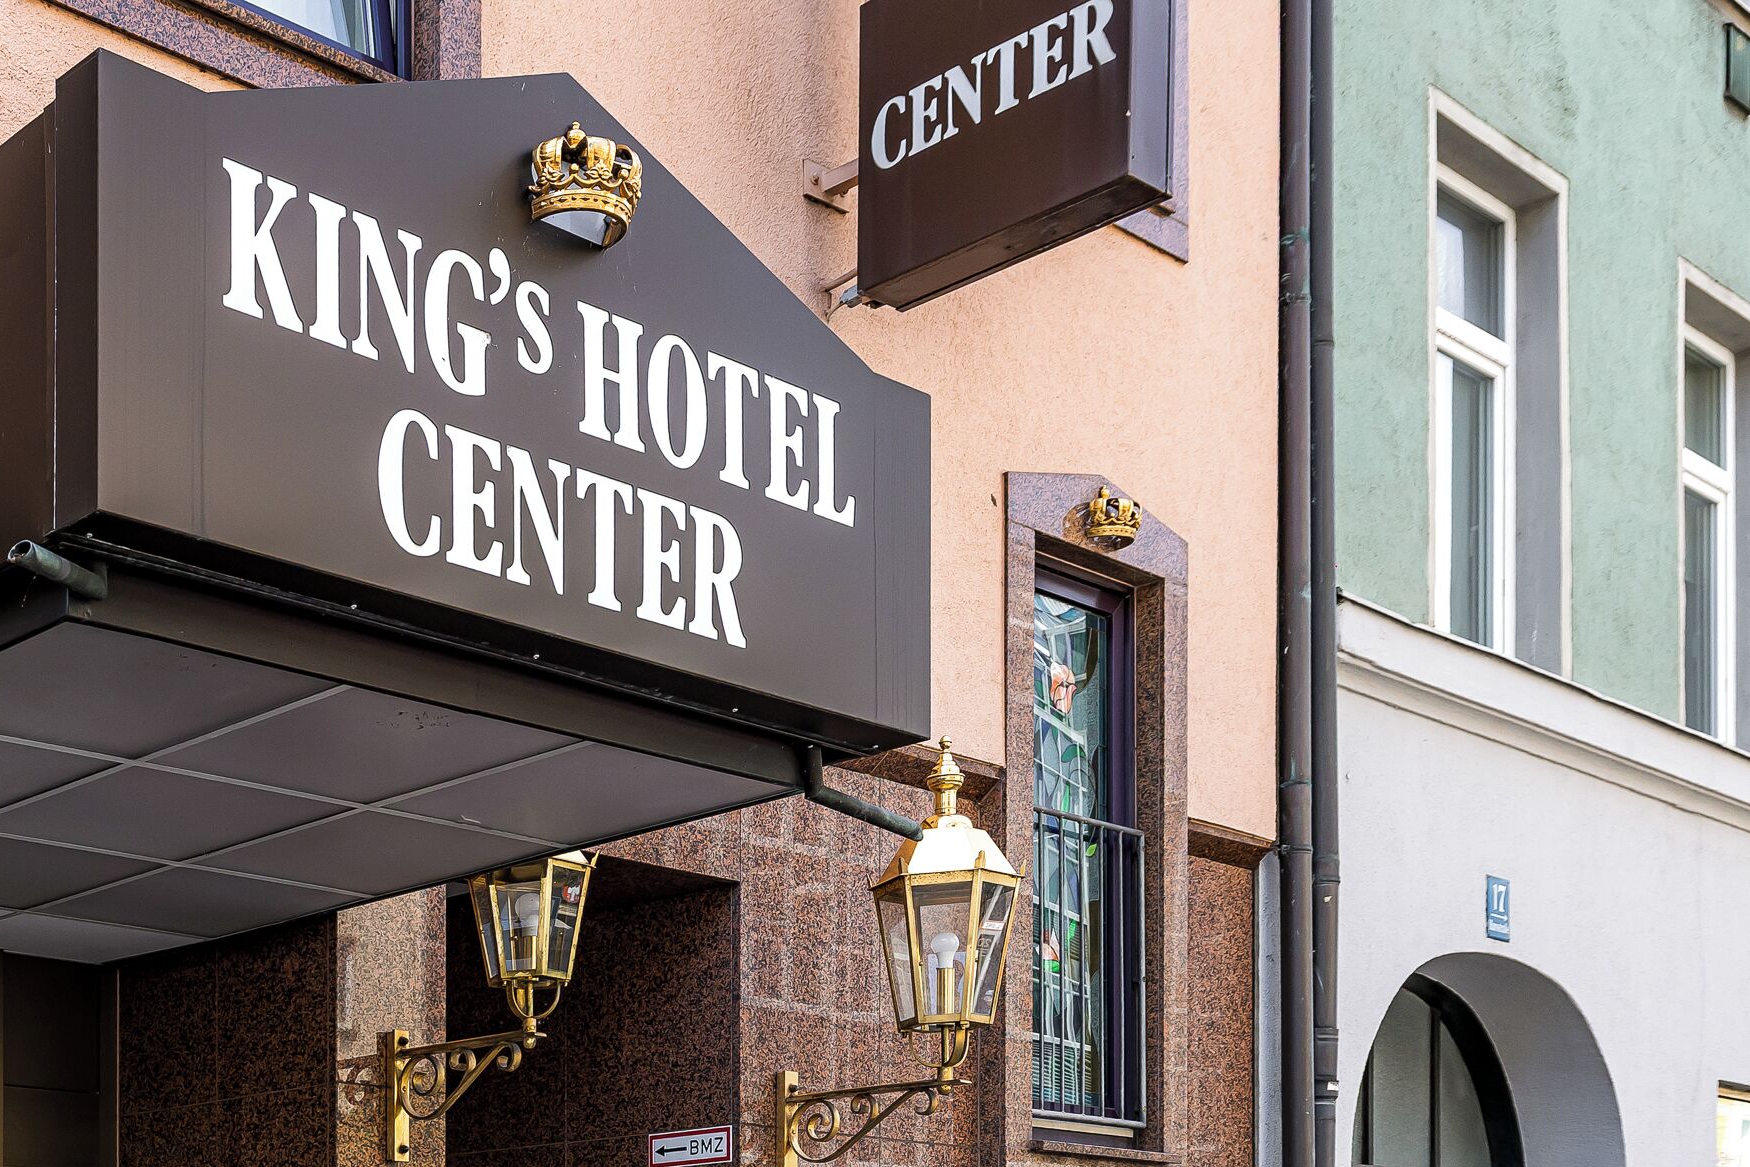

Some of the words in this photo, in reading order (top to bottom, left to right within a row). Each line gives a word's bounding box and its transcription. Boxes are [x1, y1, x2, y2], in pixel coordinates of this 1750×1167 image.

[871, 0, 1117, 170] CENTER
[576, 300, 856, 528] HOTEL
[377, 408, 748, 650] CENTER
[1492, 883, 1507, 912] 17
[689, 1136, 724, 1156] BMZ
